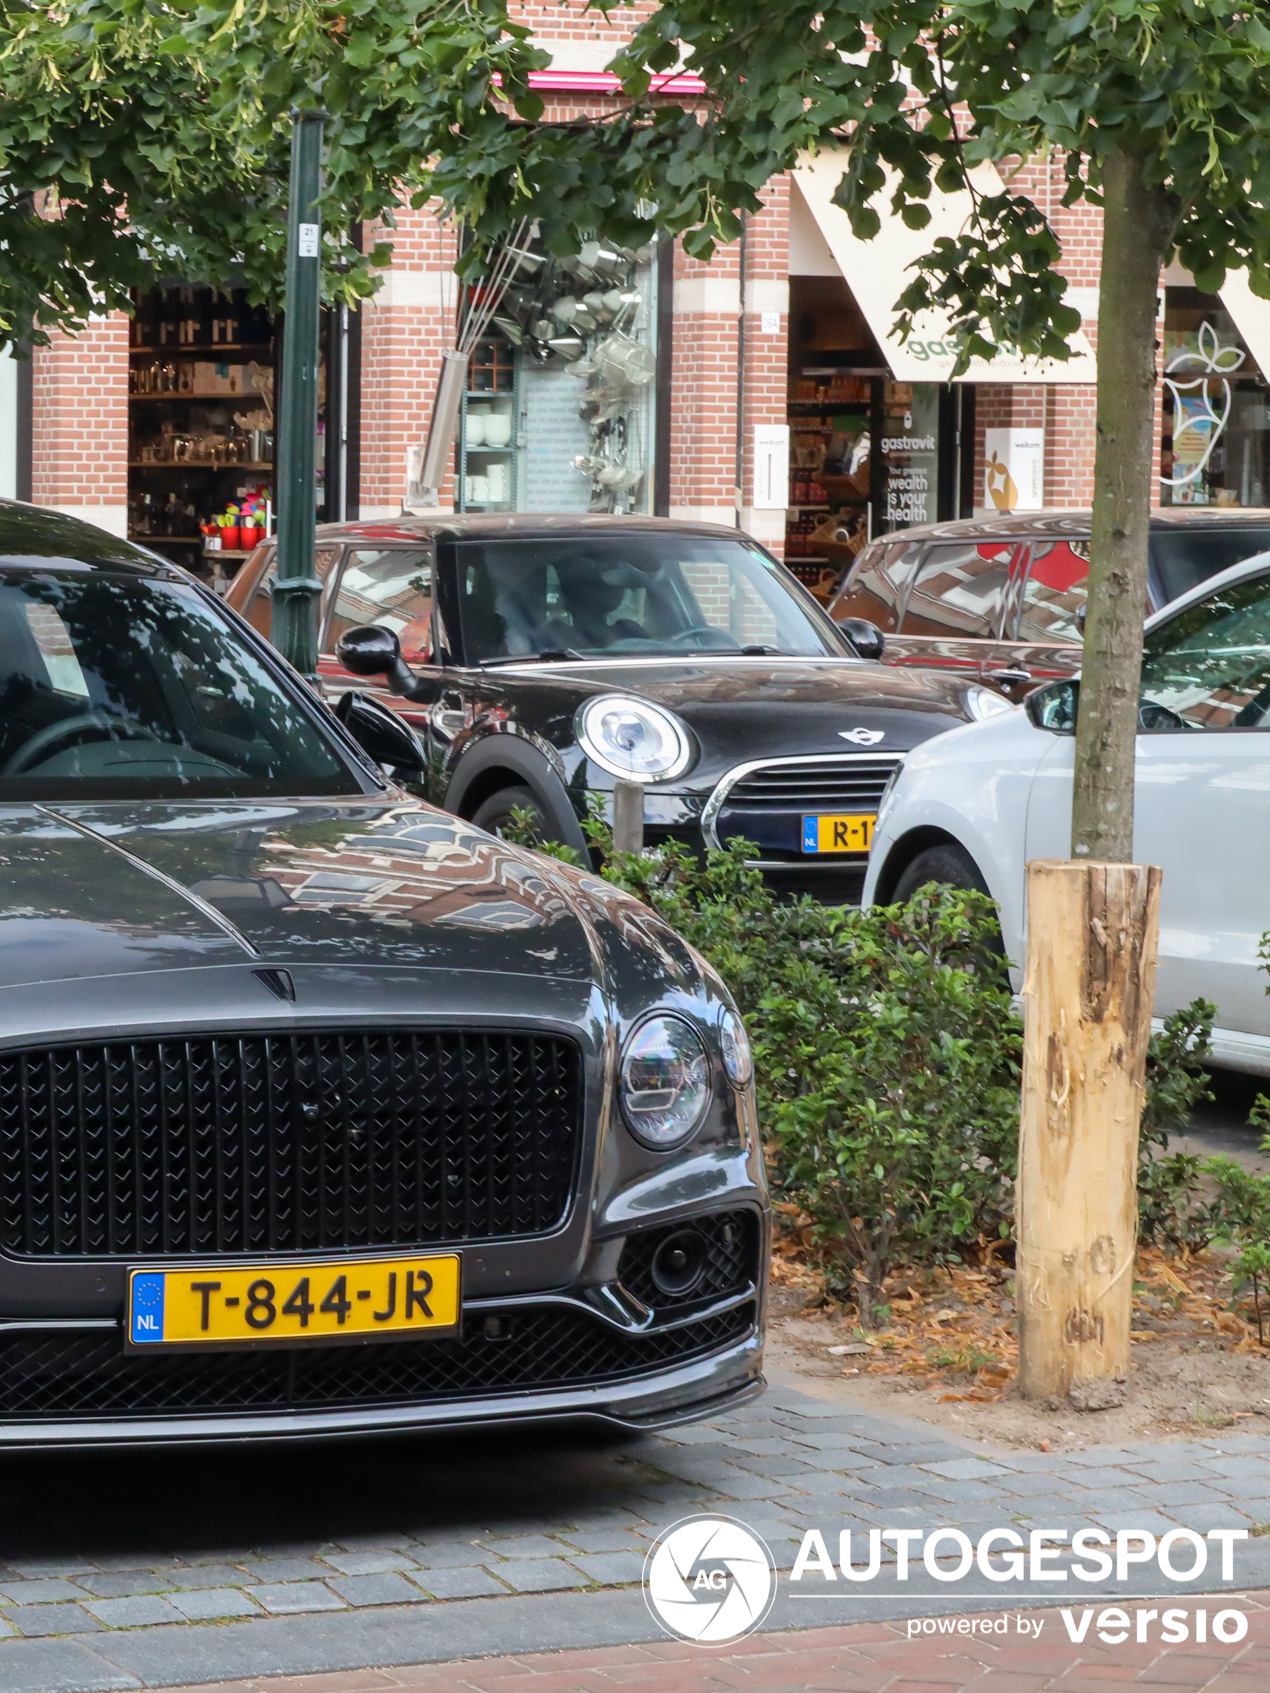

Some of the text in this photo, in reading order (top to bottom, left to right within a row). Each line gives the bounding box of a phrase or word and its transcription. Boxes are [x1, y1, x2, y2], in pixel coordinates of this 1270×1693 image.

[881, 434, 936, 454] gastrovit
[888, 475, 928, 490] wealth
[887, 488, 928, 508] is your
[887, 505, 928, 521] health
[804, 838, 817, 847] NL
[190, 1269, 434, 1331] T-844-JR
[137, 1314, 160, 1331] NL
